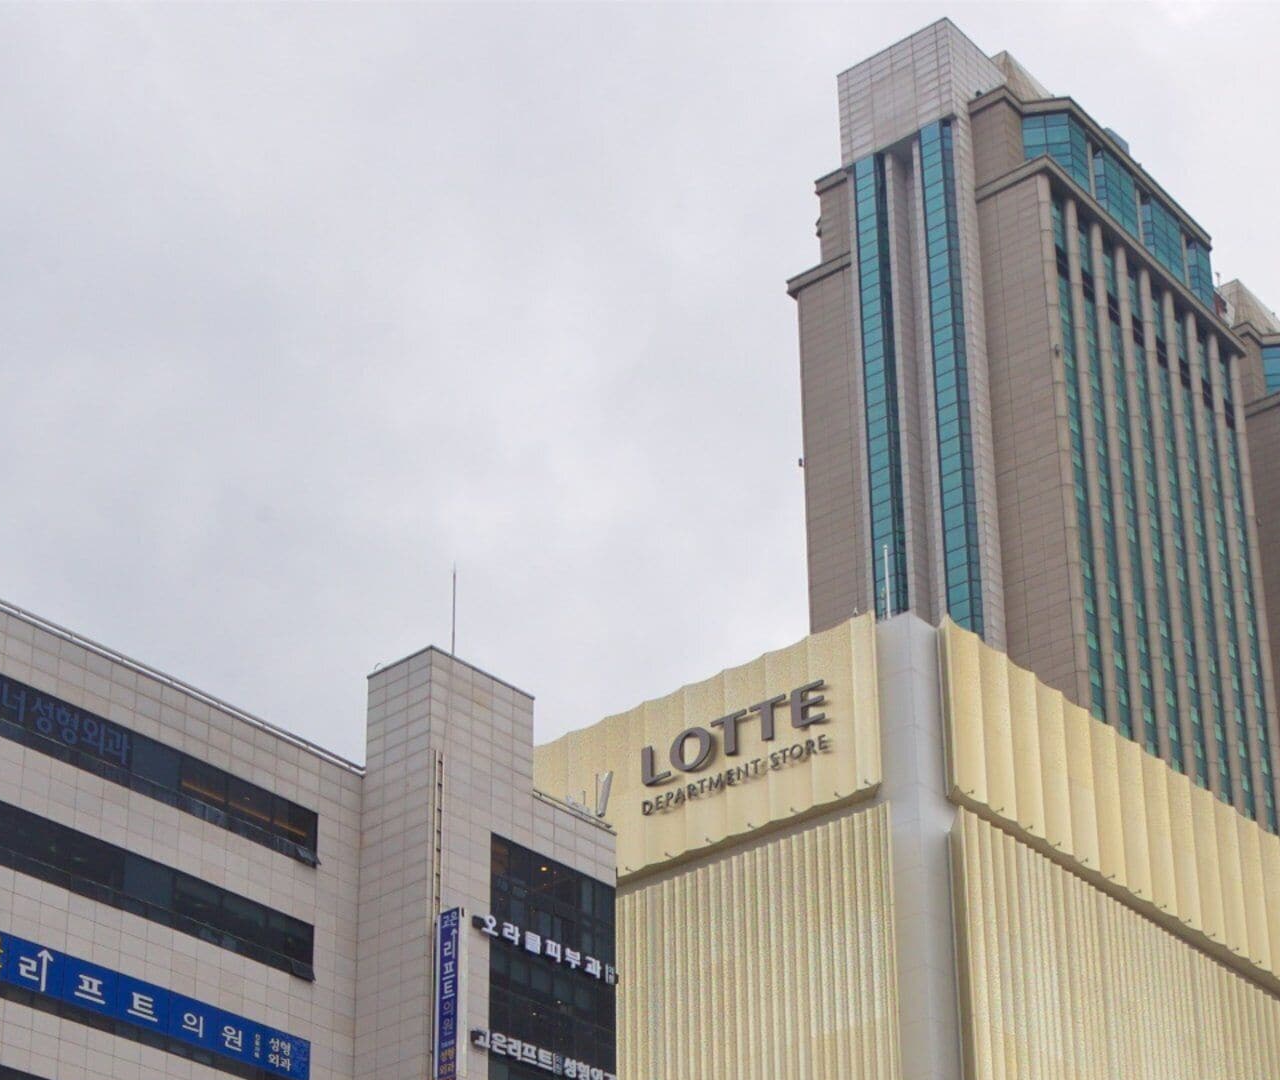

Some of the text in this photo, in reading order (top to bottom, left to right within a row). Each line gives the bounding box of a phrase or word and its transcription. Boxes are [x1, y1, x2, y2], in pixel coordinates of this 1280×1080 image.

[641, 679, 825, 786] LOTTE
[642, 734, 828, 815] DEPARTMENT STORE
